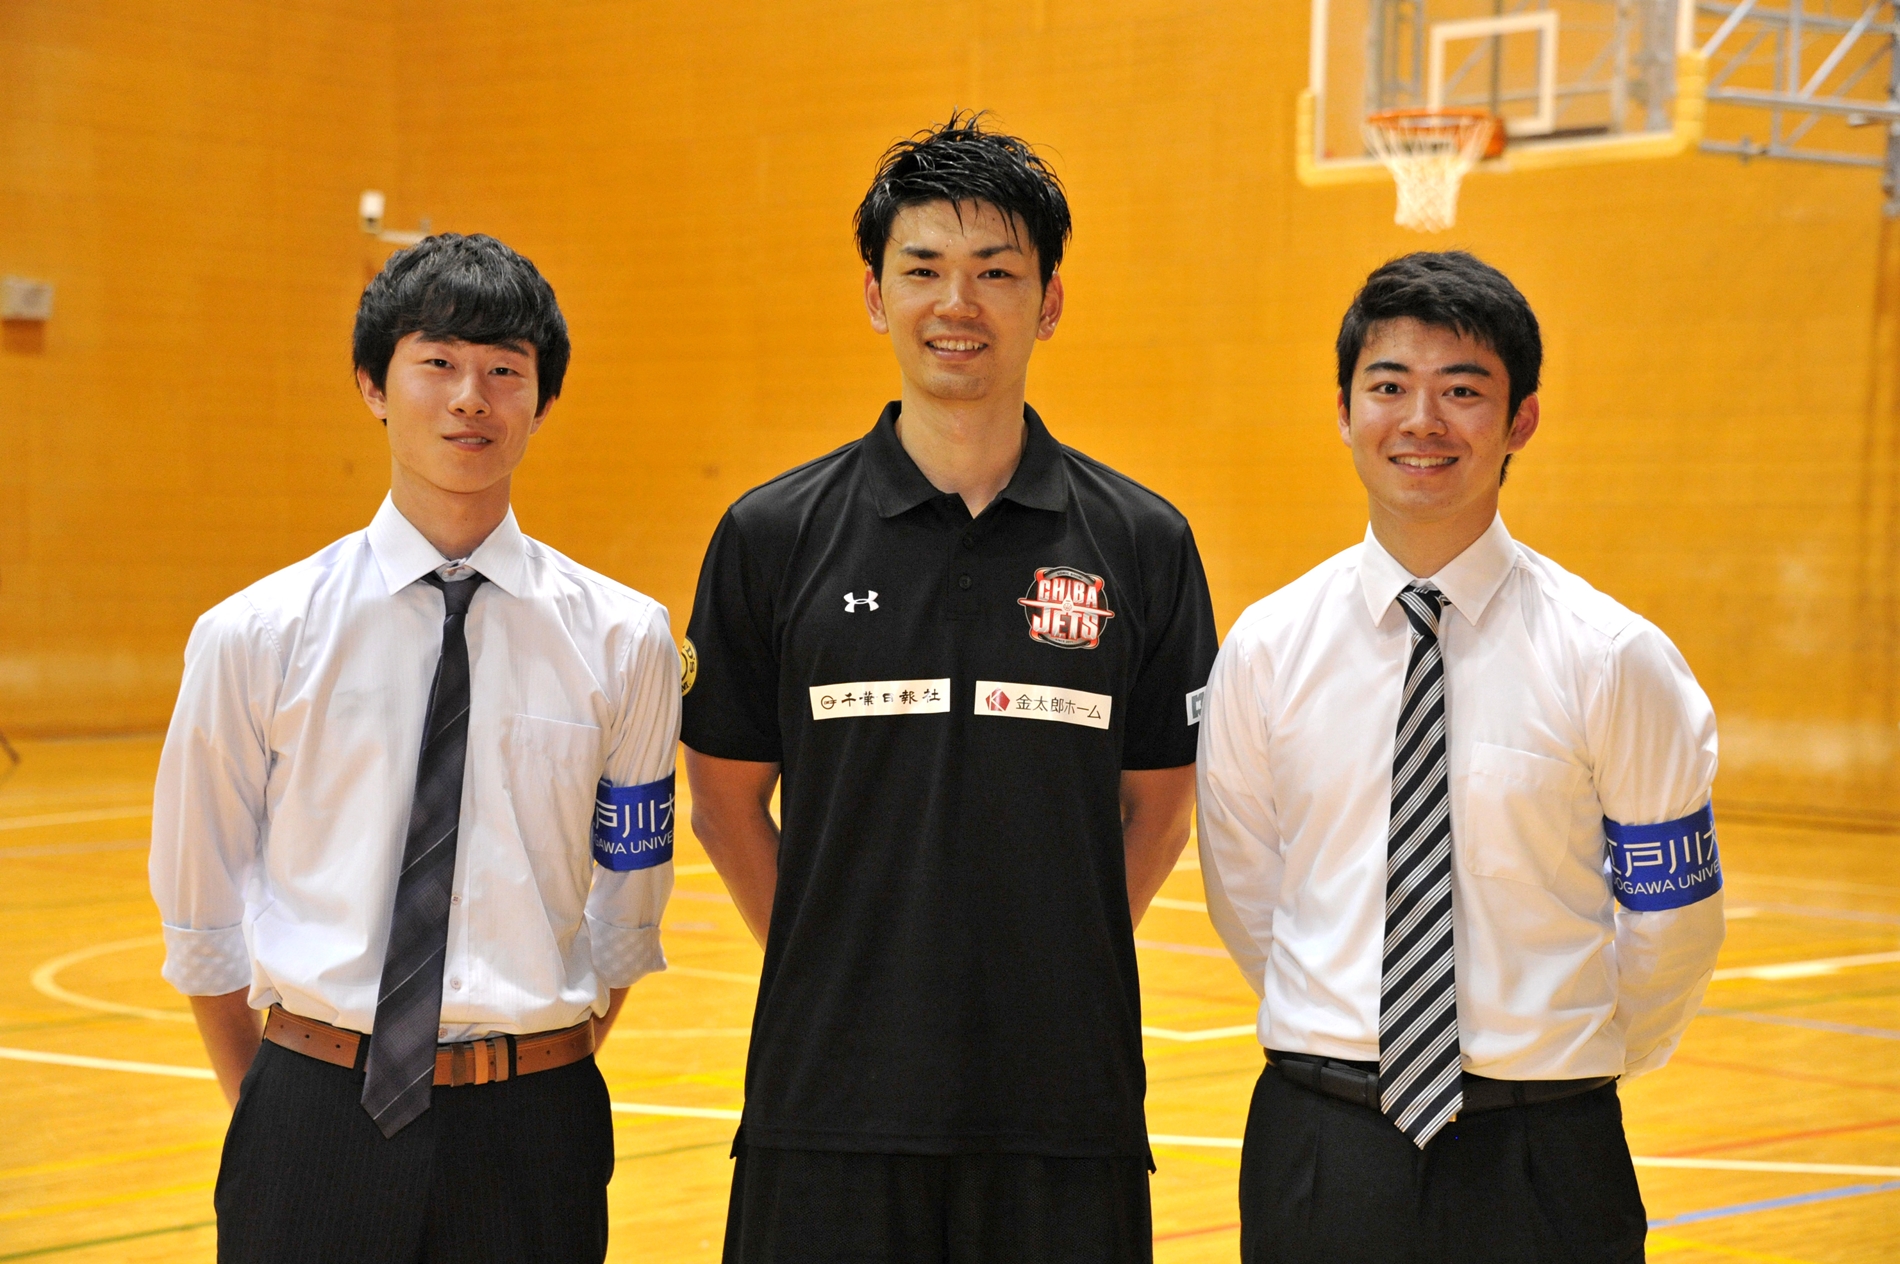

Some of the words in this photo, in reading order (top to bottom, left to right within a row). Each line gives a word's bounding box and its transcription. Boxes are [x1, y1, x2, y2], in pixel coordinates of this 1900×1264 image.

[1037, 578, 1098, 608] CHIBA
[1031, 606, 1099, 640] JETS
[841, 688, 941, 707] 千葉日報社
[1015, 693, 1102, 719] 金太郎ホーム
[630, 830, 673, 854] UNIVE
